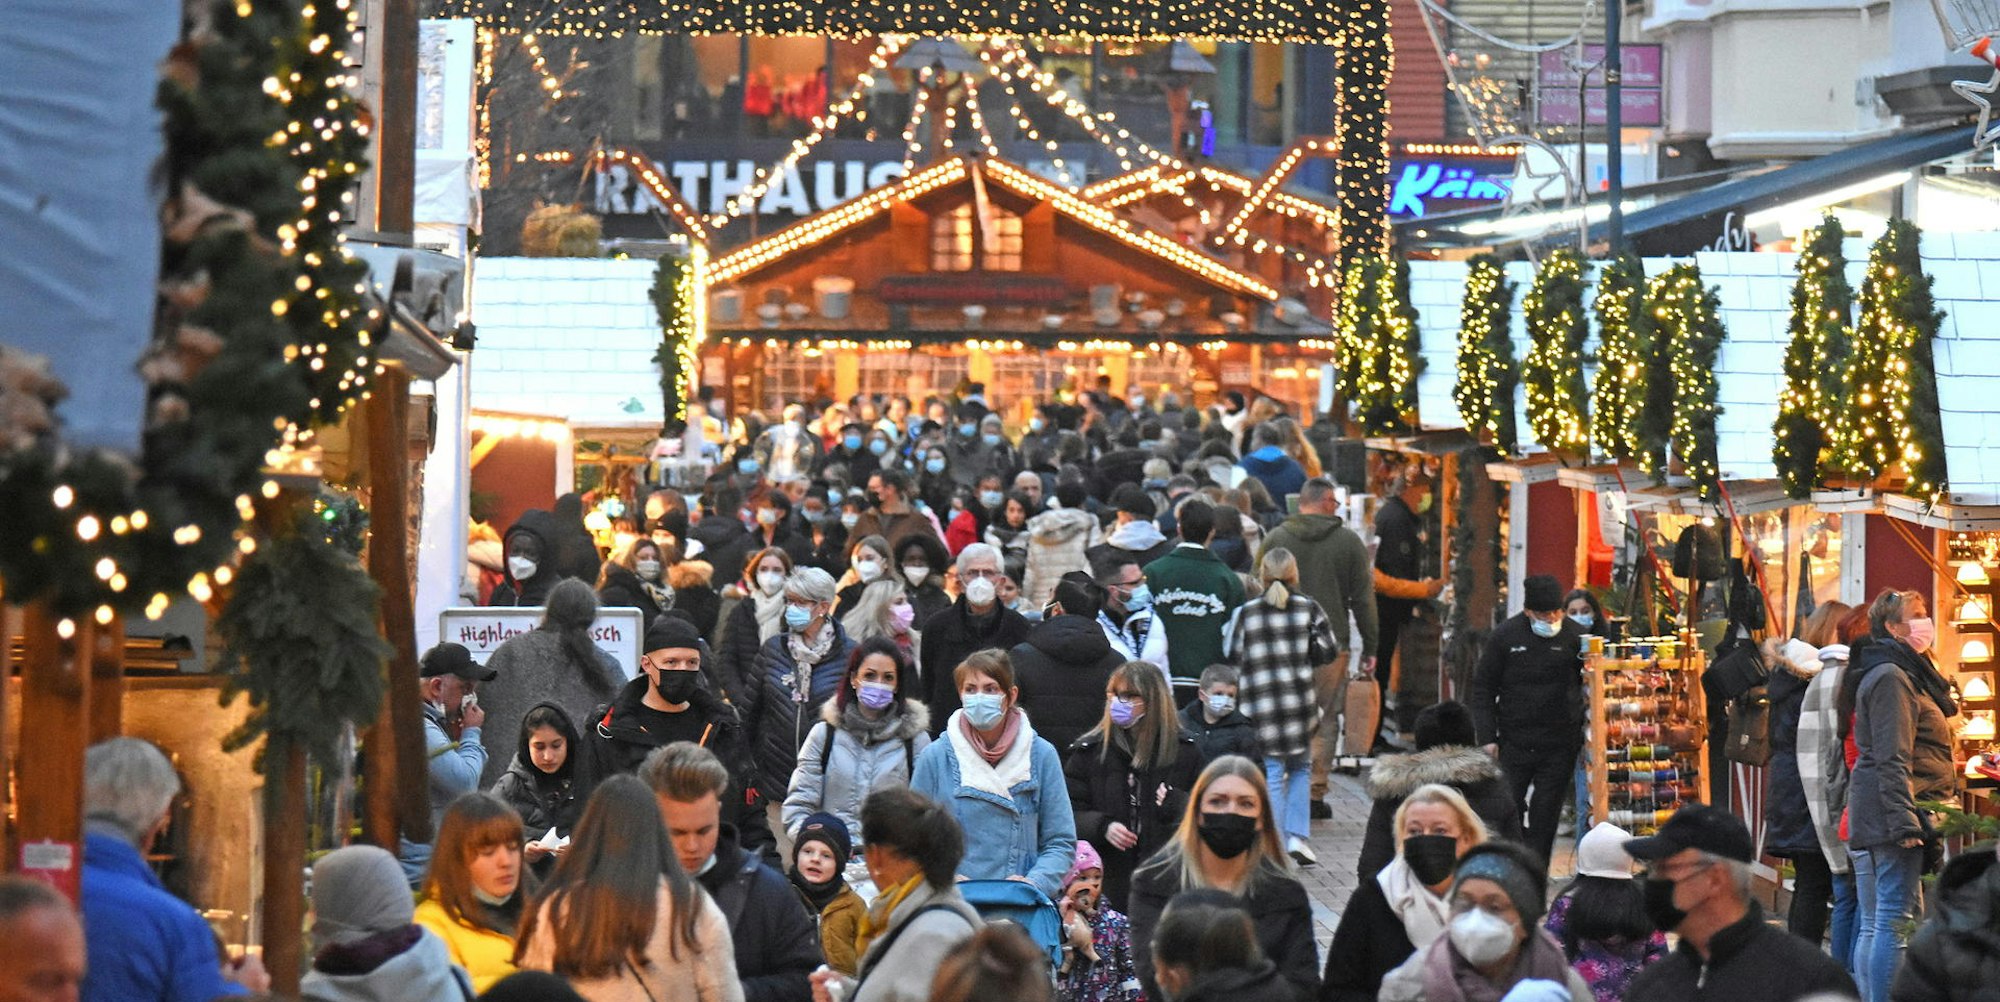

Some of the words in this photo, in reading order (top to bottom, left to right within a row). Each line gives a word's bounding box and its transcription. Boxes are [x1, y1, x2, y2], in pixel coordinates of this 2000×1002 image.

[1172, 601, 1208, 617] club
[460, 621, 534, 648] Highla
[590, 624, 621, 642] sch
